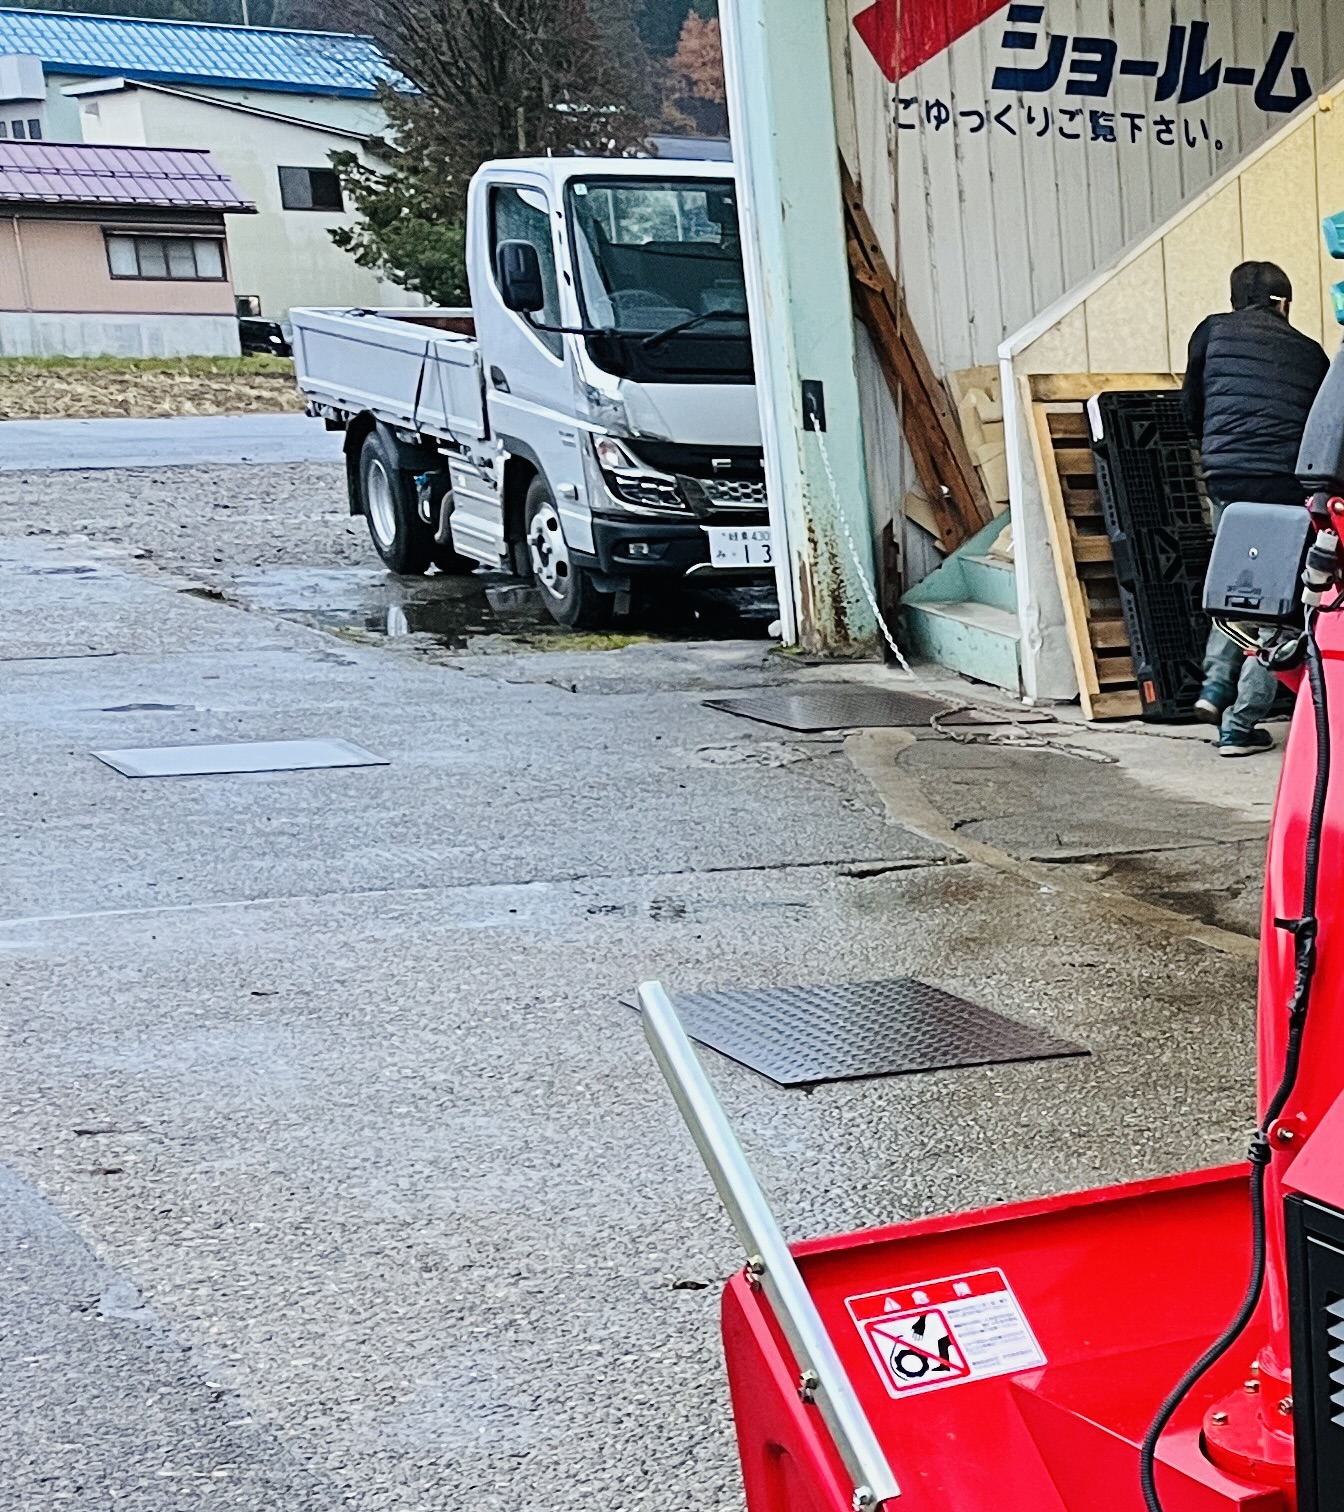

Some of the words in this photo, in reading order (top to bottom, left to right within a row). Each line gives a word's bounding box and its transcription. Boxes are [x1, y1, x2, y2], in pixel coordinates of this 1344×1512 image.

[991, 4, 1313, 113] ショールーム
[892, 96, 1224, 151] ごゆっくりご覧下さい。
